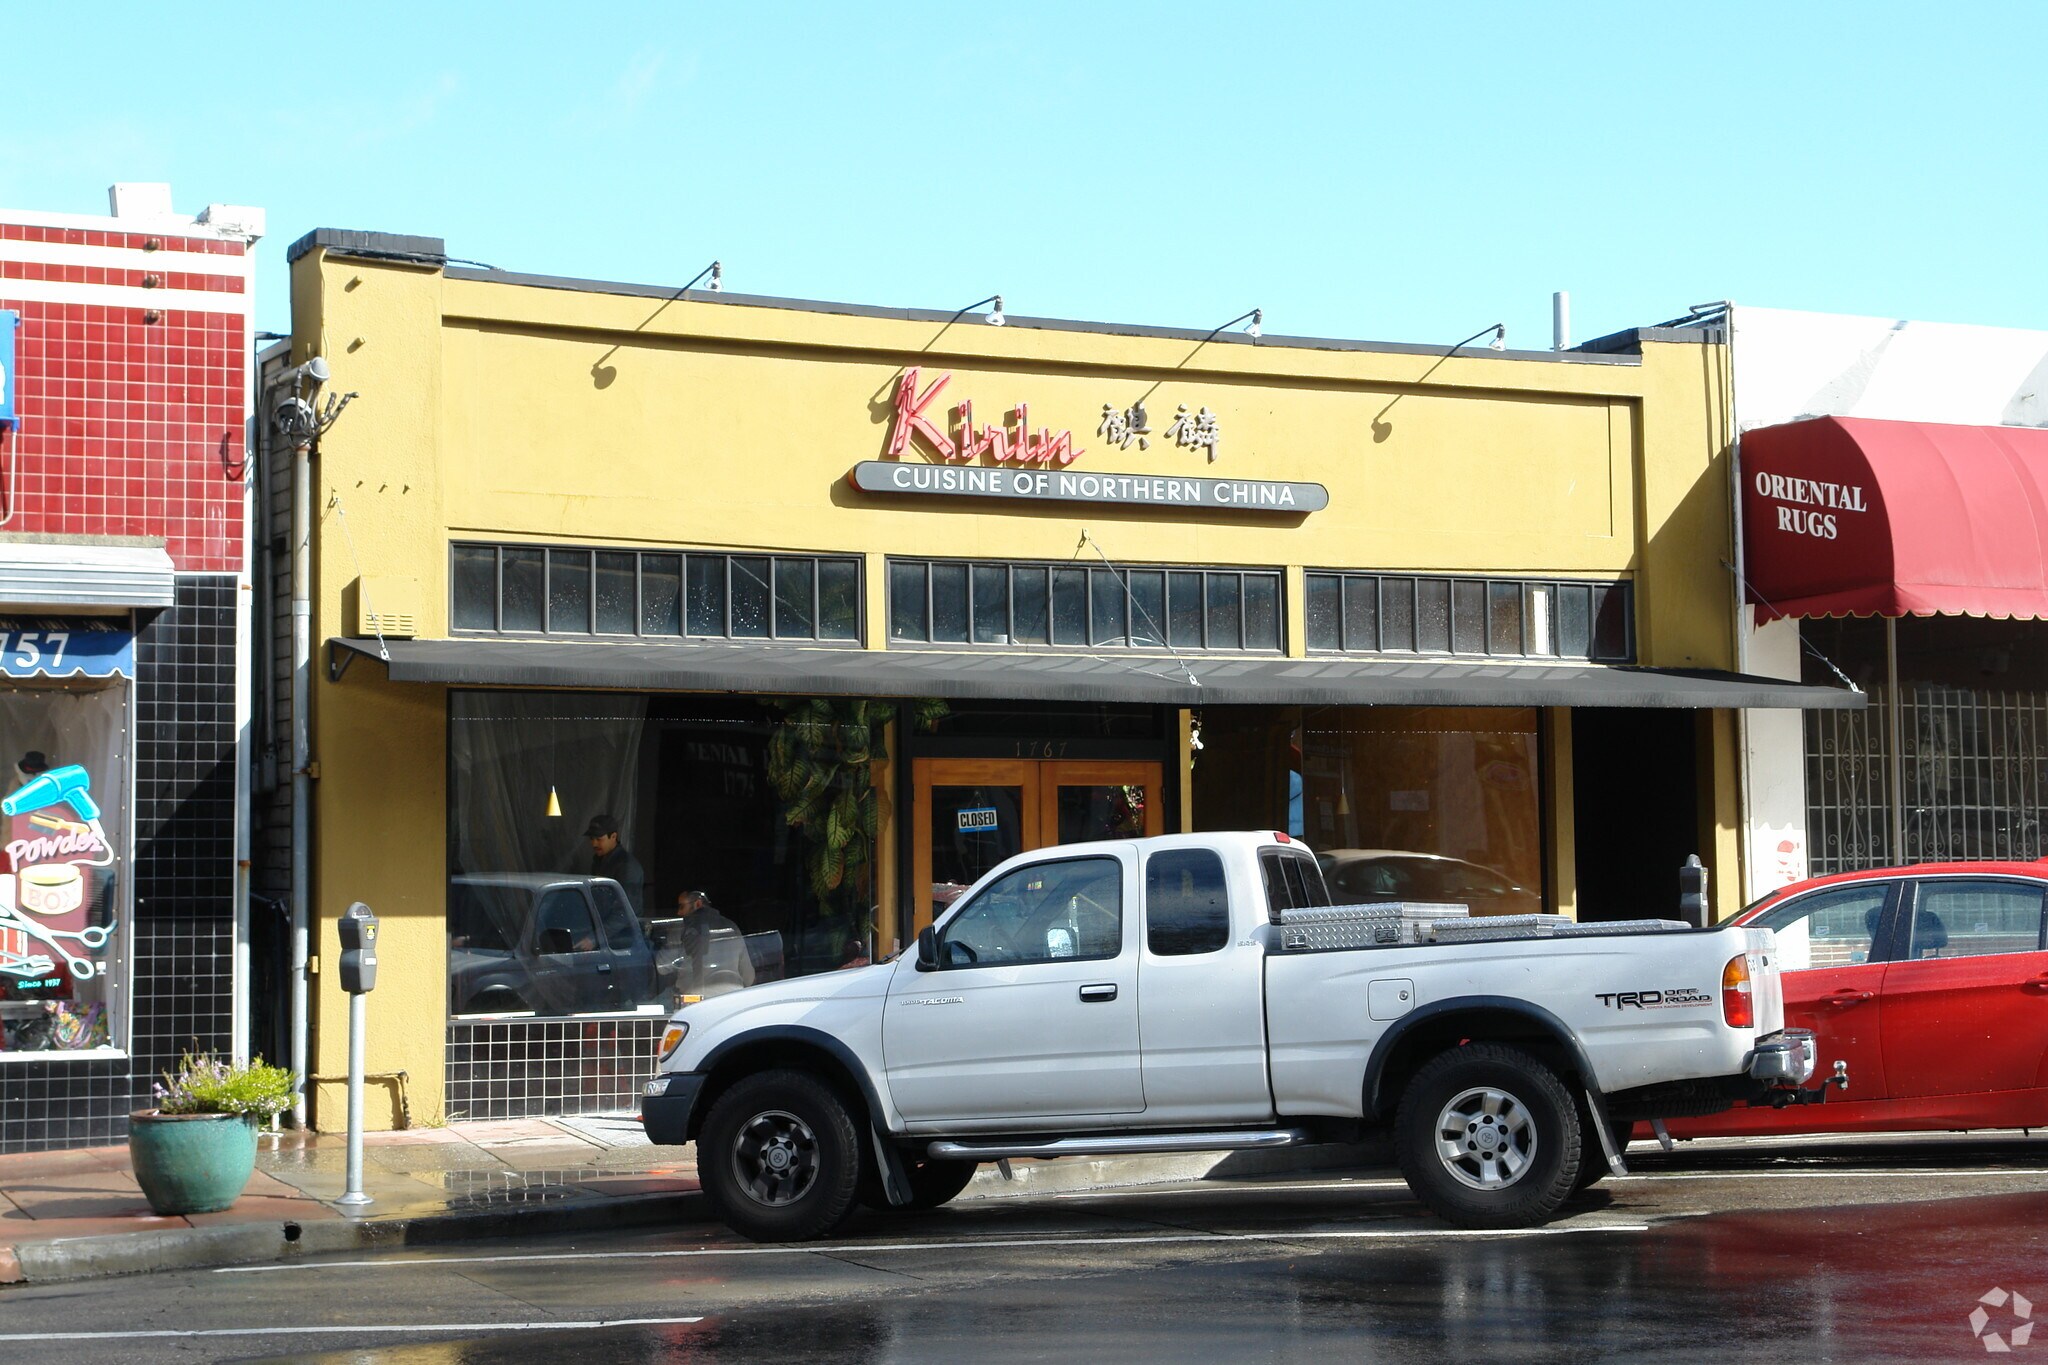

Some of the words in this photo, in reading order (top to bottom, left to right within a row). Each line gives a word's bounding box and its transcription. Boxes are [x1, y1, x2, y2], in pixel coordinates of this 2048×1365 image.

[888, 366, 1085, 464] Kirin
[893, 466, 1002, 493] CUISINE
[1013, 473, 1049, 495] OF
[1060, 475, 1201, 502] NORTHERN
[1213, 482, 1296, 506] CHINA
[1755, 471, 1867, 513] ORIENTAL
[1776, 506, 1838, 540] RUGS
[1015, 742, 1067, 758] 1767
[959, 811, 995, 827] CLOSED
[28, 887, 78, 910] BOX
[17, 980, 42, 989] Since
[1664, 988, 1699, 996] OFF
[1595, 990, 1663, 1011] TRD
[1664, 994, 1713, 1004] ROAD
